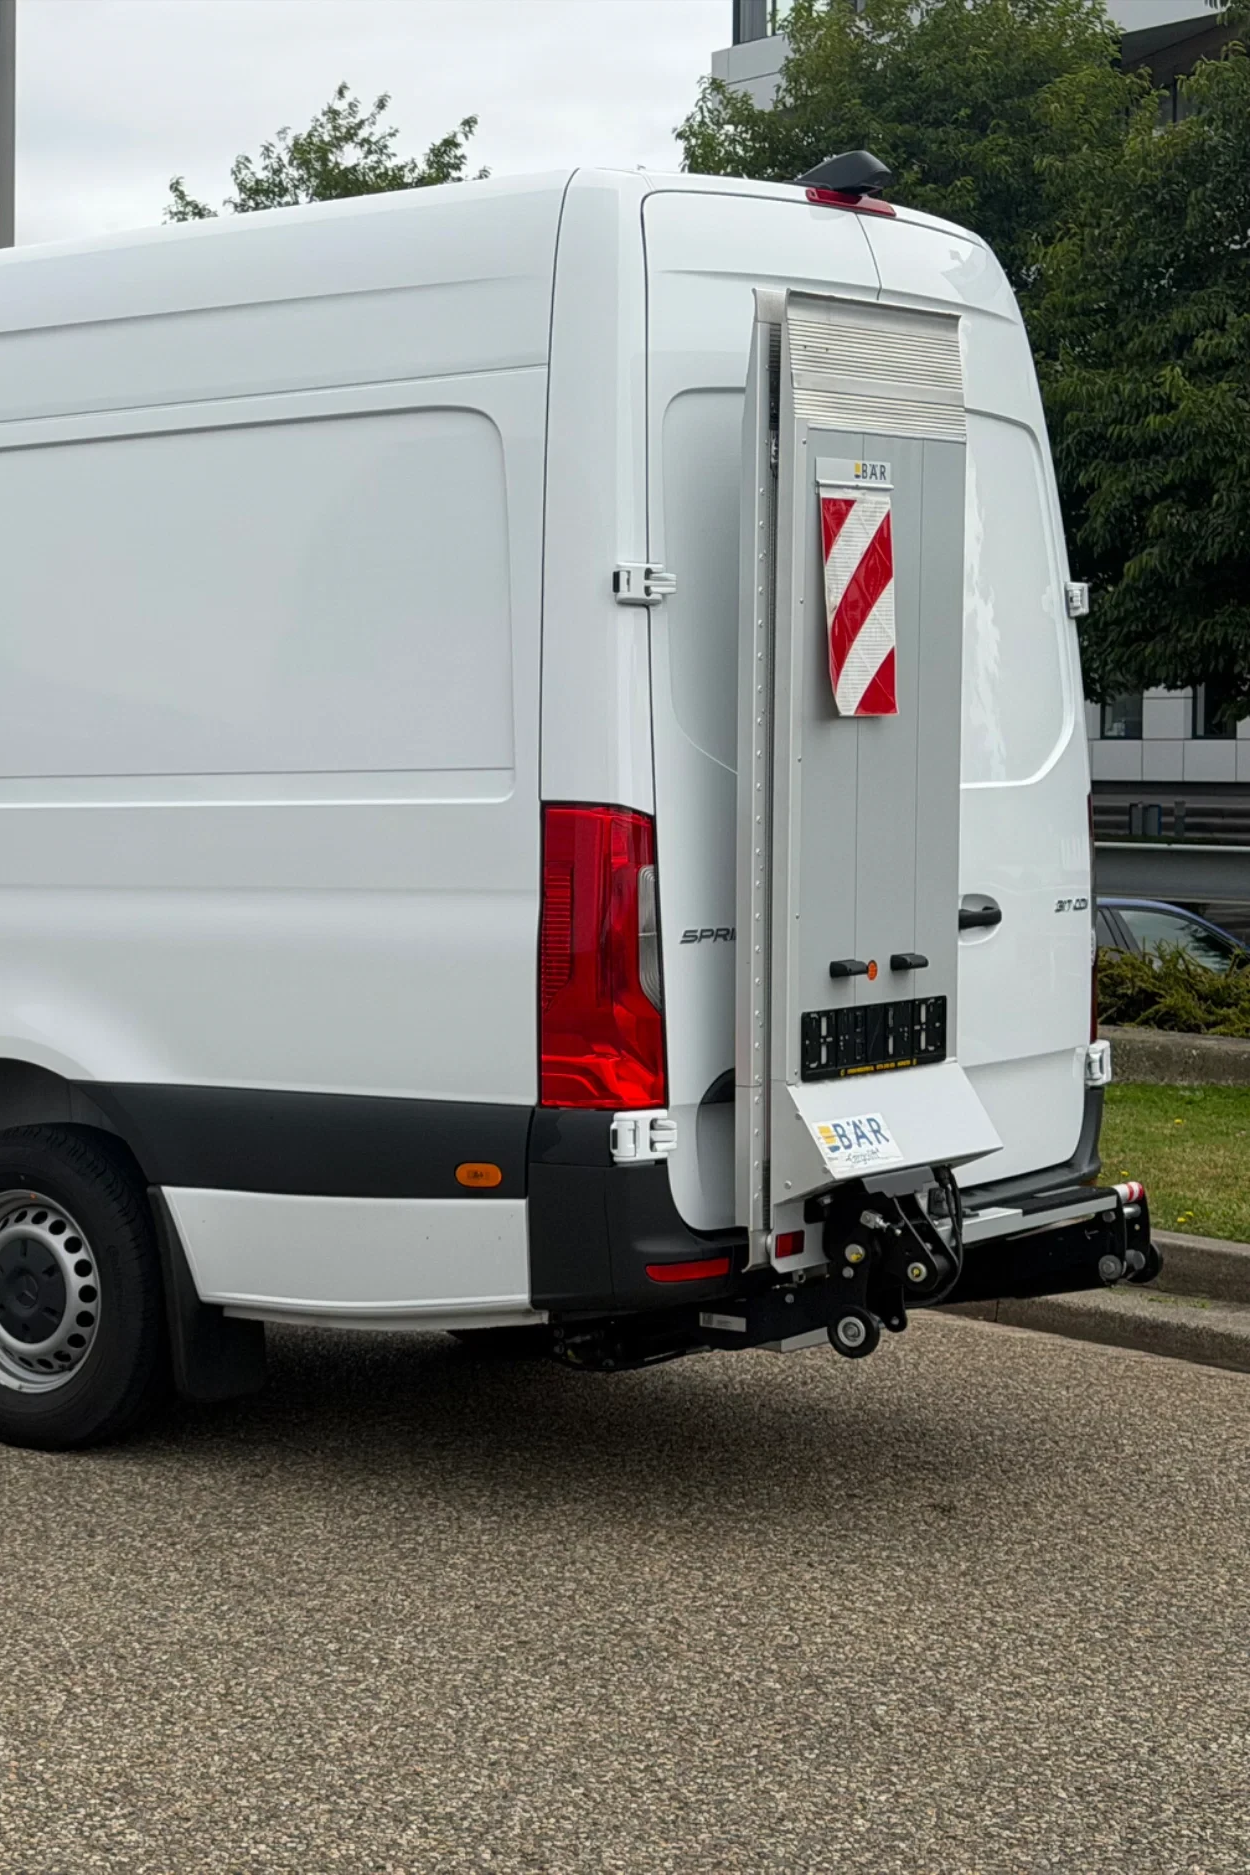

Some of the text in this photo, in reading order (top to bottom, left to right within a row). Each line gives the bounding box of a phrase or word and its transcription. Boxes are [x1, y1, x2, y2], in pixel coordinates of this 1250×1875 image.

[862, 463, 886, 480] BÄR
[679, 927, 736, 944] SPRI
[831, 1117, 890, 1150] BÄR
